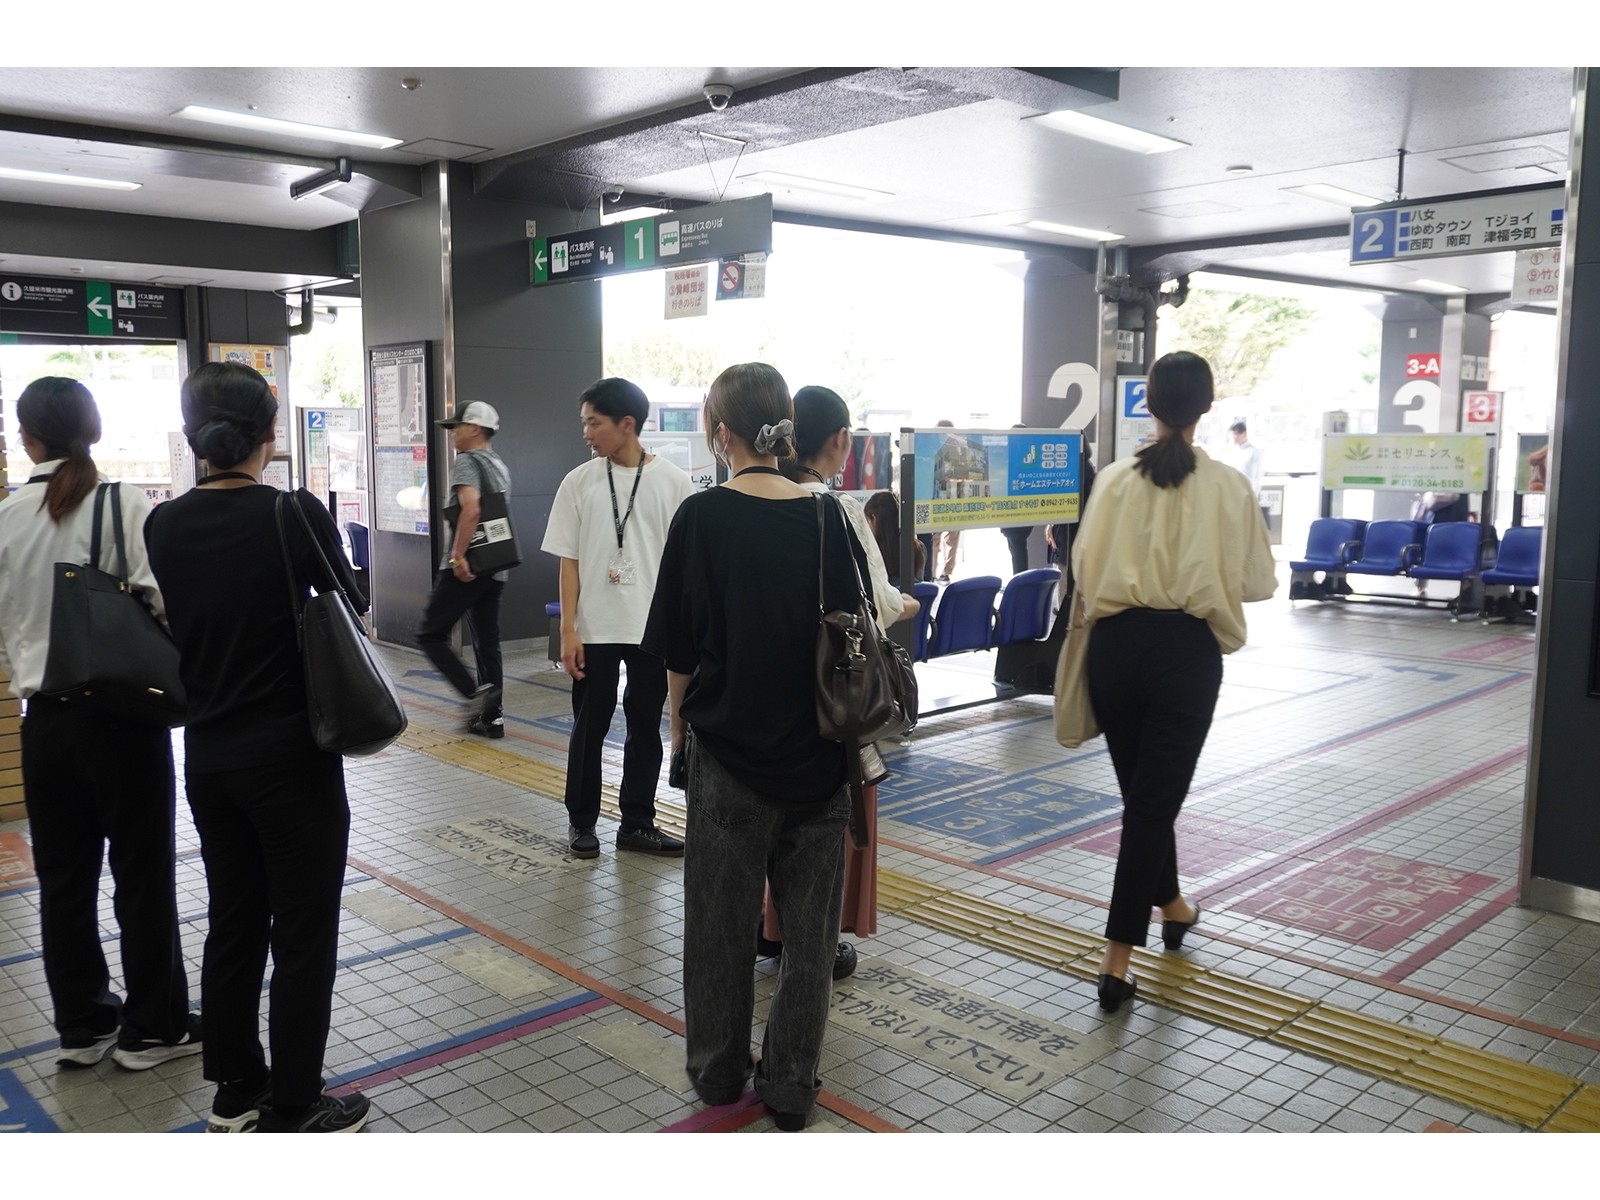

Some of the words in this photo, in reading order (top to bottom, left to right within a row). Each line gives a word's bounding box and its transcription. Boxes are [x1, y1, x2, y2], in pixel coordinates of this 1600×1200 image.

[681, 218, 723, 234] 高速バスのりば
[1411, 209, 1435, 221] 八女
[1411, 220, 1472, 236] ゆめタウン
[1485, 212, 1534, 228] Tジョイ
[569, 241, 594, 253] バス案内所
[634, 227, 644, 260] 1
[1360, 218, 1385, 253] 2
[1410, 238, 1434, 251] 西町
[1446, 234, 1471, 246] 南町
[1484, 226, 1537, 243] 津福今町
[1529, 284, 1558, 295] 行きの
[1407, 358, 1439, 375] 3-A
[1047, 362, 1099, 455] 2
[1131, 383, 1148, 414] 2
[1392, 379, 1441, 433] 3
[1473, 395, 1490, 420] 3
[312, 412, 322, 428] 2
[1392, 448, 1451, 459] セリエンス
[1021, 479, 1076, 489] ホームエステートアオイ
[996, 791, 1079, 813] 医療
[1024, 783, 1101, 803] 国分
[965, 798, 1055, 823] センター
[944, 816, 988, 830] 3
[1331, 861, 1462, 895] 竹の子
[1282, 906, 1359, 932] 9-1
[1367, 905, 1401, 918] 9
[851, 966, 1079, 1056] 歩行者通行帯を
[830, 990, 1045, 1087] さがないで下さい
